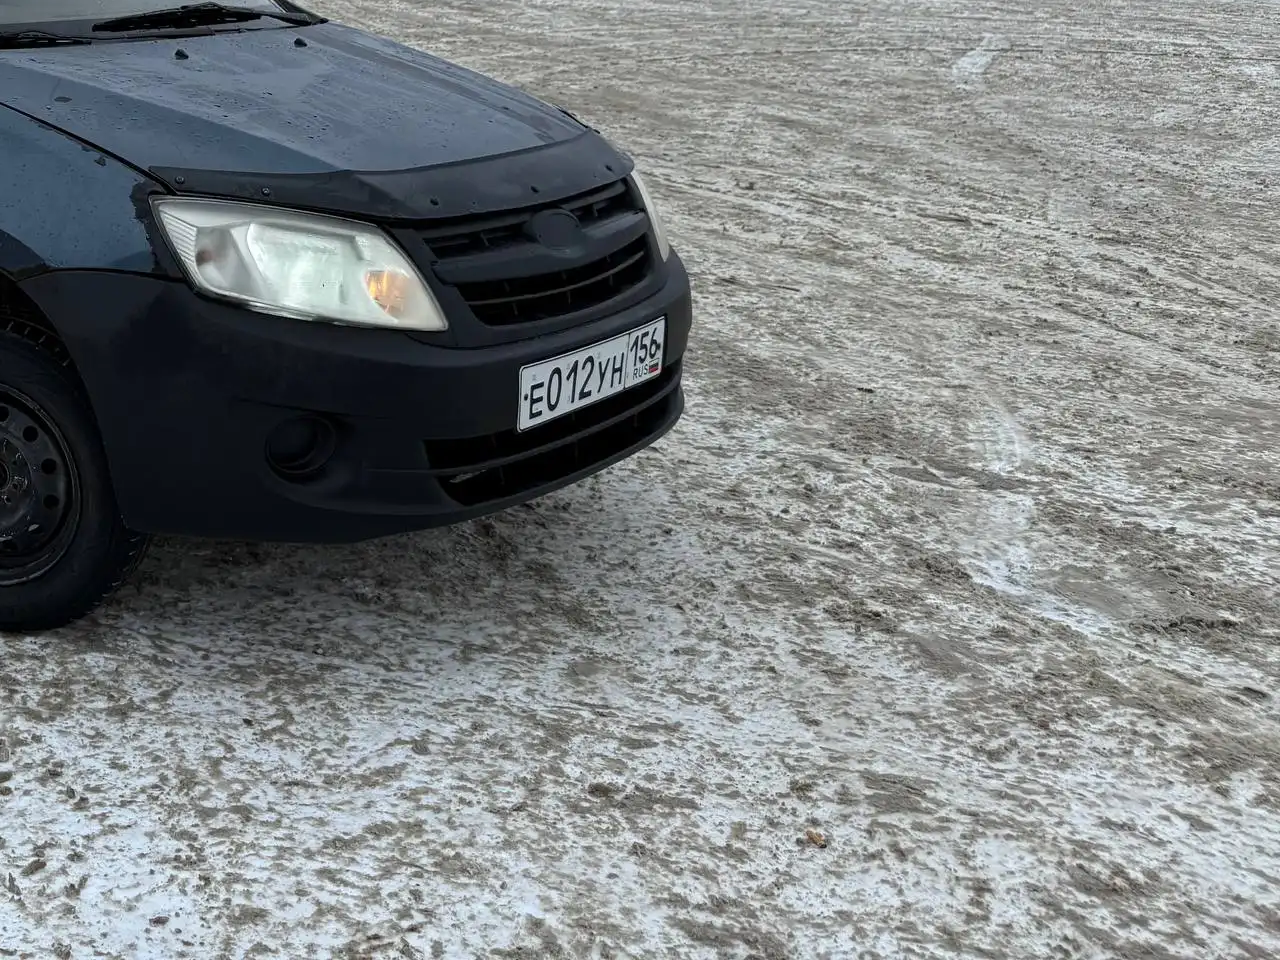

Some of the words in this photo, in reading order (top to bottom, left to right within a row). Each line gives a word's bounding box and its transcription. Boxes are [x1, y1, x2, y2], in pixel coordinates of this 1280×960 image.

[529, 352, 624, 420] Е012УН
[630, 327, 658, 367] 156
[632, 363, 649, 380] RUS
